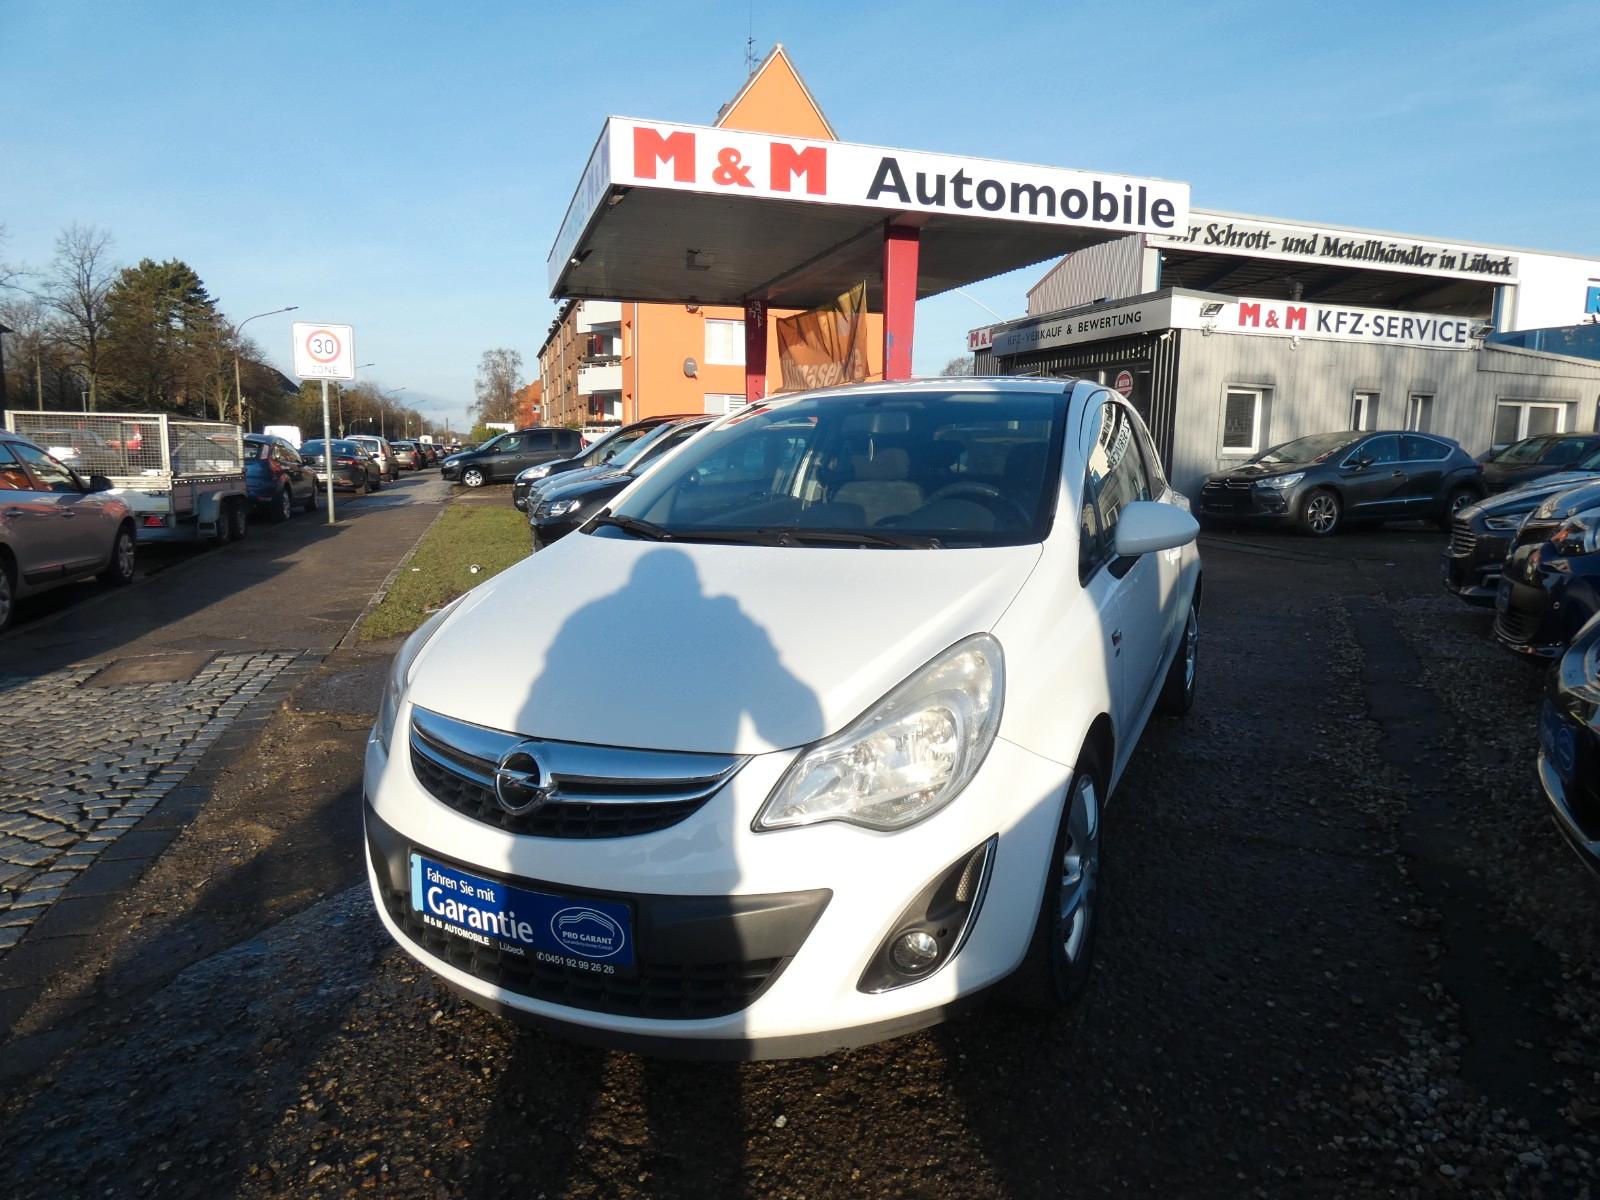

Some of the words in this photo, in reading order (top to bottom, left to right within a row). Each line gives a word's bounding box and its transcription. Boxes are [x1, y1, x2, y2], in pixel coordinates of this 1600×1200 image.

[633, 127, 696, 183] M
[712, 147, 755, 188] &
[770, 142, 827, 195] M
[866, 157, 1175, 229] Automobile
[1204, 223, 1276, 250] Schrott-
[1282, 233, 1318, 255] und
[1320, 236, 1437, 267] Metallhändler
[1439, 249, 1457, 269] in
[1460, 252, 1512, 276] Lübeck
[1066, 324, 1073, 334] &
[1078, 311, 1142, 333] BEWERTUNG
[1238, 302, 1261, 327] M
[1265, 309, 1279, 329] &
[1285, 306, 1307, 331] M
[313, 338, 334, 354] 30
[970, 332, 980, 348] M
[980, 333, 987, 345] &
[311, 365, 339, 375] ZONE
[427, 867, 457, 890] Fahren
[460, 880, 474, 896] Sie
[477, 888, 496, 903] mit
[427, 886, 534, 943] Garantie
[423, 914, 430, 924] M
[430, 917, 436, 926] &
[436, 920, 443, 929] M
[444, 923, 490, 946] AUTOMOBILE
[562, 930, 578, 940] PRO
[579, 934, 613, 945] GARANT
[499, 942, 525, 956] Lübeck
[545, 953, 564, 965] 0451
[566, 958, 577, 968] 92
[579, 960, 589, 970] 99
[591, 963, 601, 973] 26
[603, 965, 615, 975] 26
